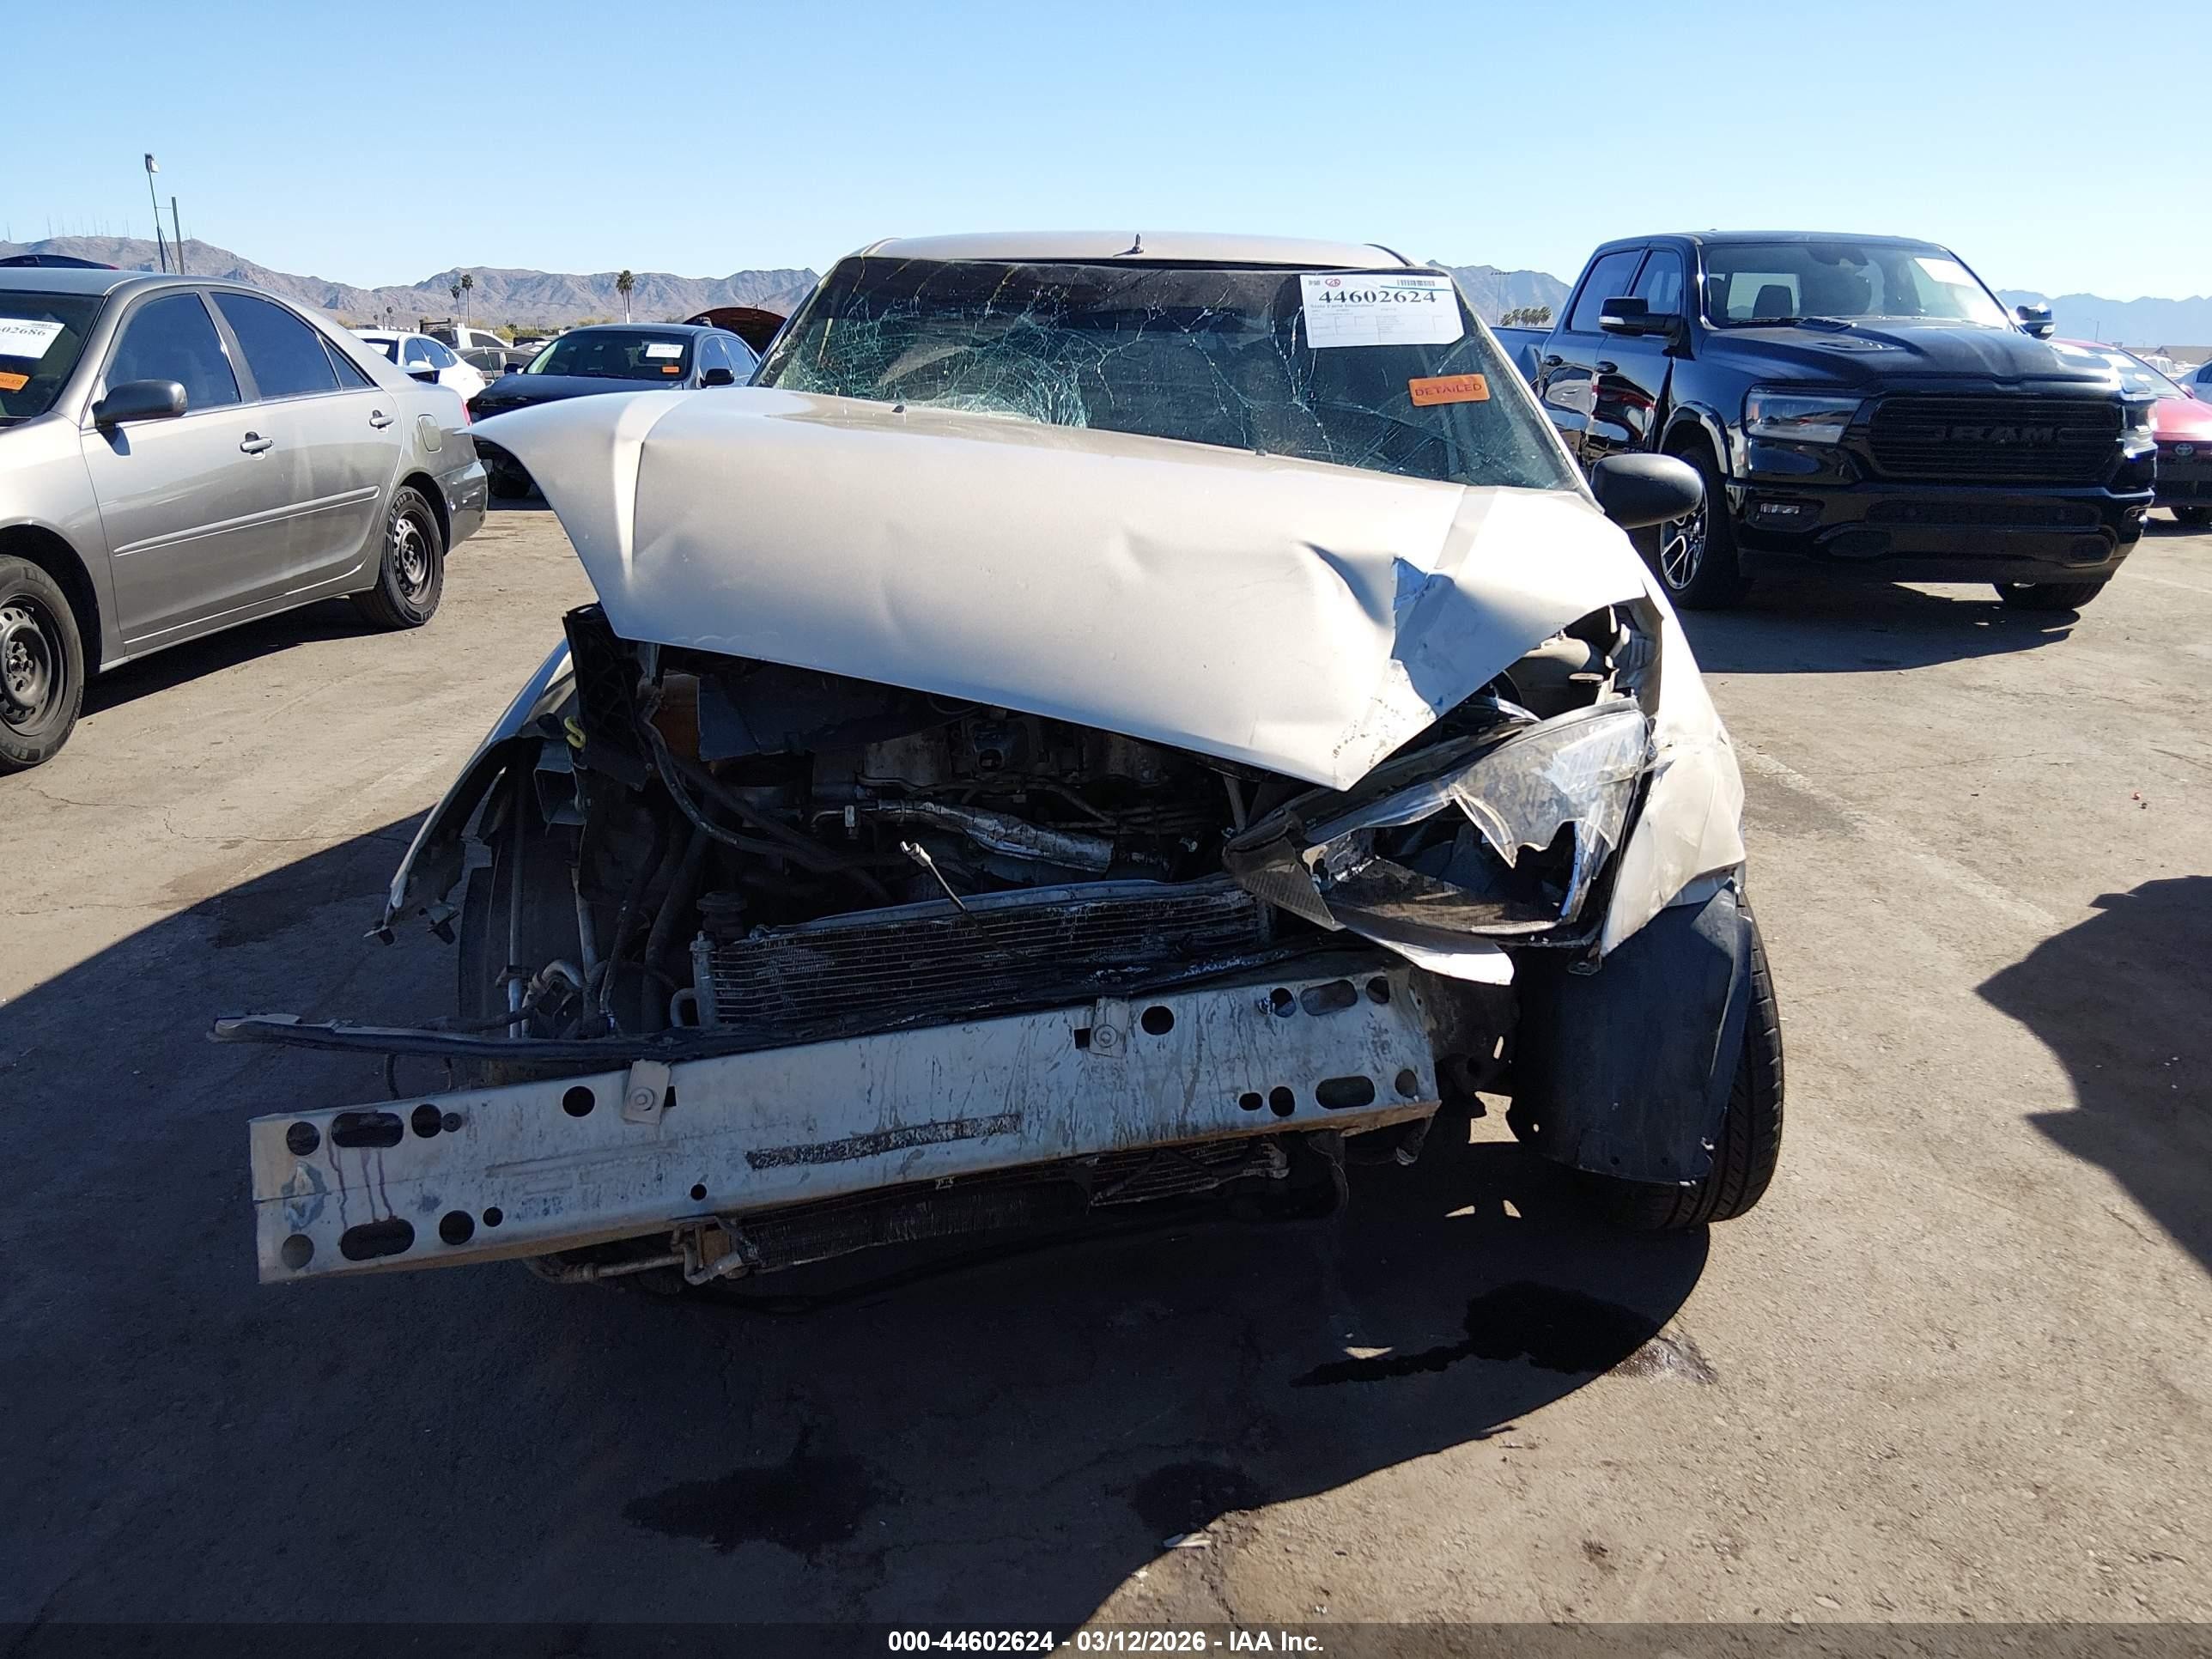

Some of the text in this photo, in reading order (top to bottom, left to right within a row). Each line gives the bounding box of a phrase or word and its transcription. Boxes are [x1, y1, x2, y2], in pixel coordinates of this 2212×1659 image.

[1318, 289, 1437, 304] 44602624
[0, 326, 46, 336] 02686
[1414, 383, 1482, 397] DETAILED
[1950, 425, 2055, 442] RAM
